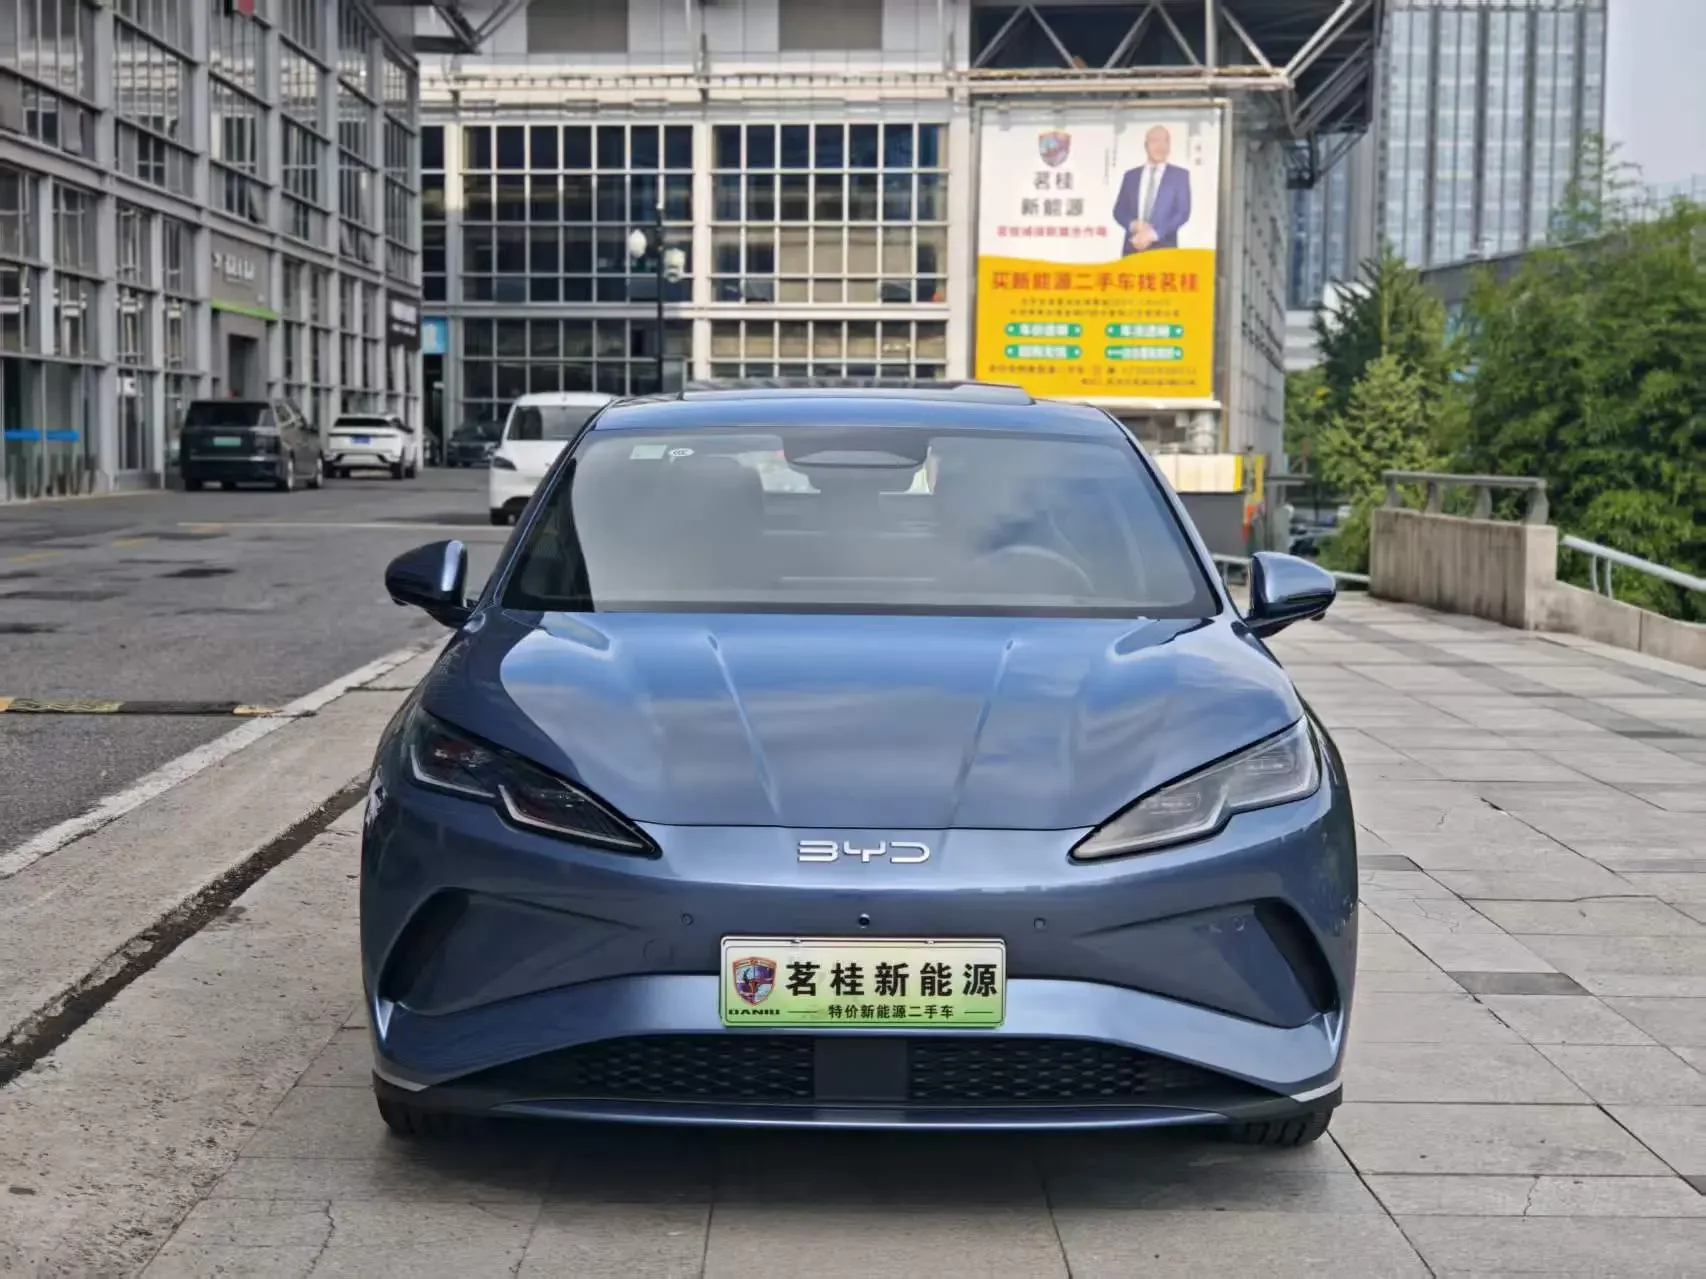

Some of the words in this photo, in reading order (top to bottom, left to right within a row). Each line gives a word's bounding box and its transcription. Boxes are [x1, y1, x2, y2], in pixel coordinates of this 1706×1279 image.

[1033, 171, 1074, 191] 茗桂
[1021, 198, 1085, 217] 新能源
[992, 272, 1198, 293] 买新能源二手车找茗桂
[797, 839, 931, 864] BYD
[785, 961, 999, 998] 茗桂新能源
[828, 1004, 955, 1019] 特价新能源二手车
